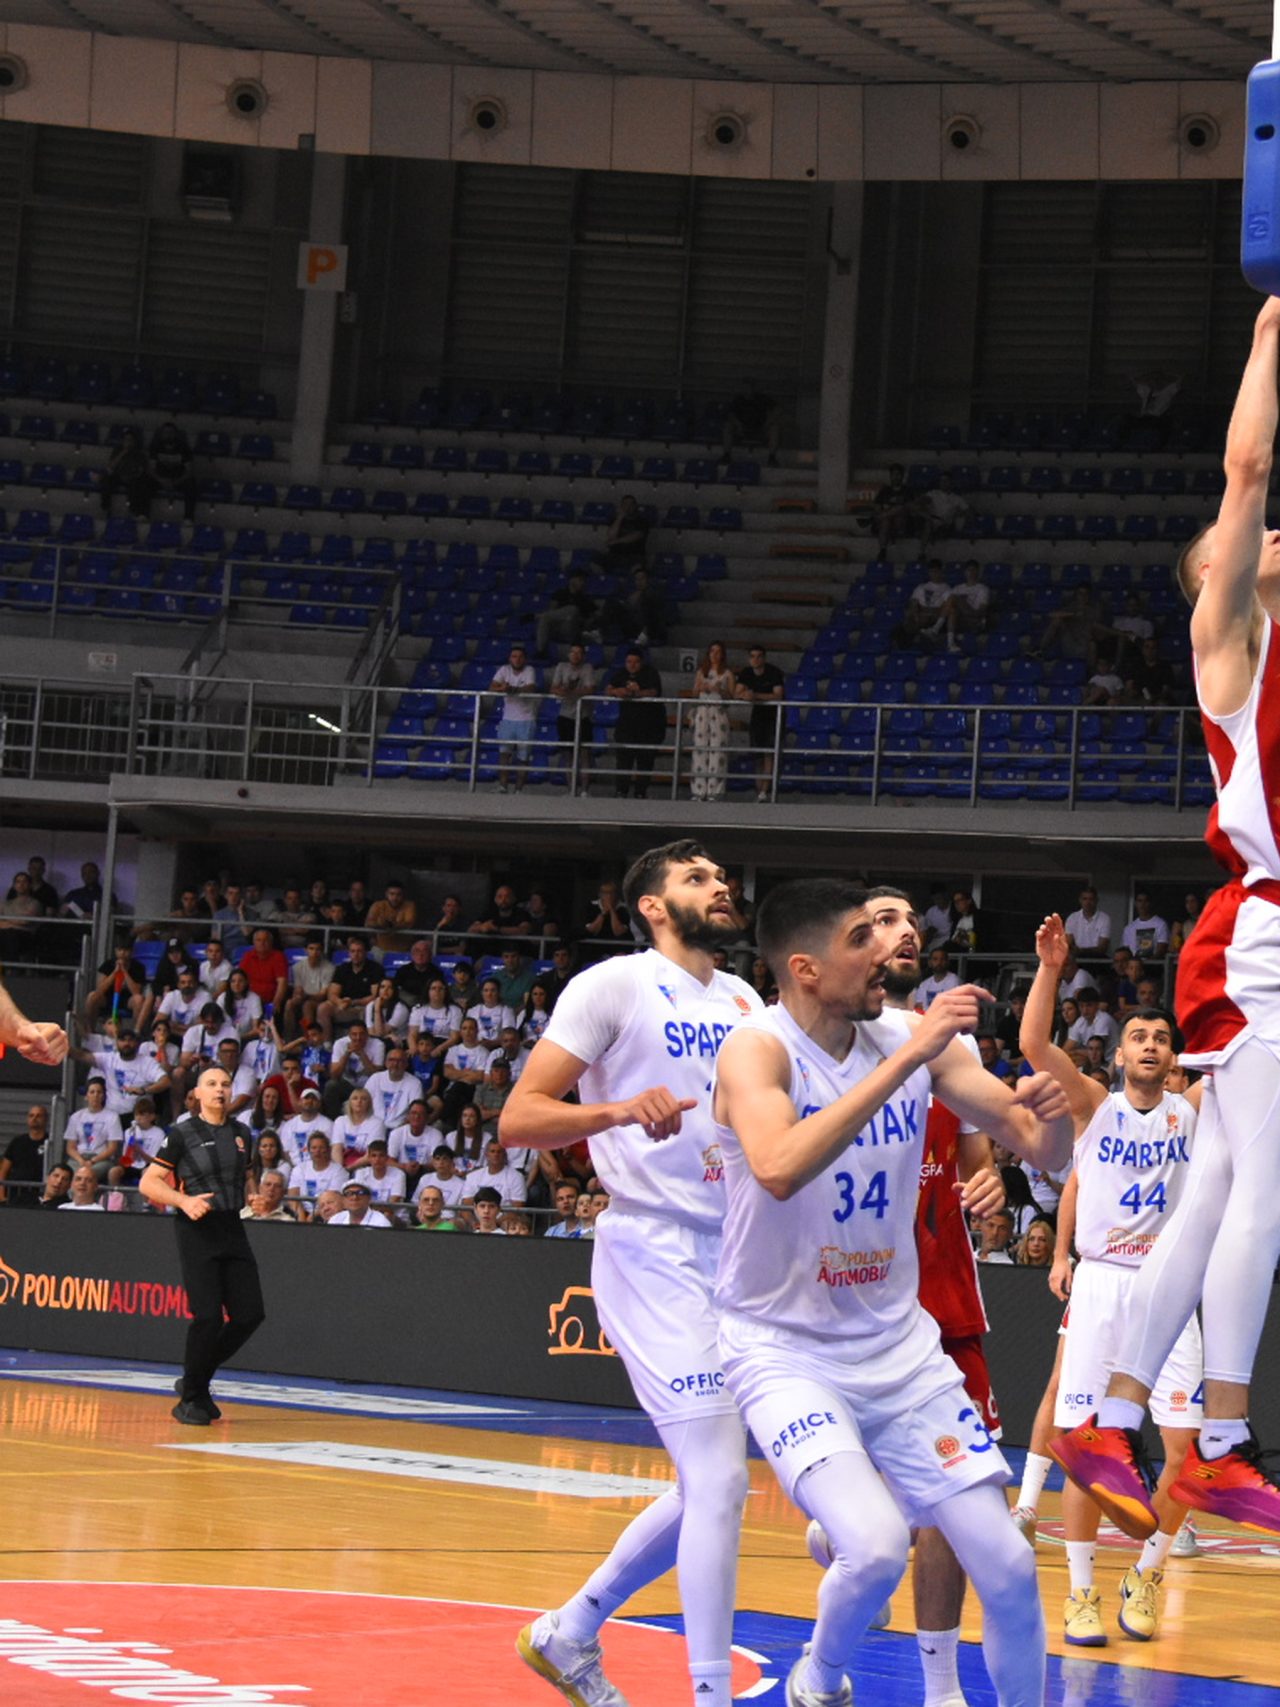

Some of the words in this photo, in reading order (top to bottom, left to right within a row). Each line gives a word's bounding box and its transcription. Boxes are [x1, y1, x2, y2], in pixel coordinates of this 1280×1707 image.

[307, 248, 337, 284] P
[684, 656, 694, 672] 6
[664, 1021, 733, 1058] SPAR
[1098, 1135, 1189, 1168] SPARTAK
[833, 1170, 889, 1223] 34
[1120, 1182, 1167, 1214] 44
[670, 1372, 725, 1393] OFFIC
[772, 1411, 838, 1458] OFFICE
[958, 1407, 1000, 1454] 3
